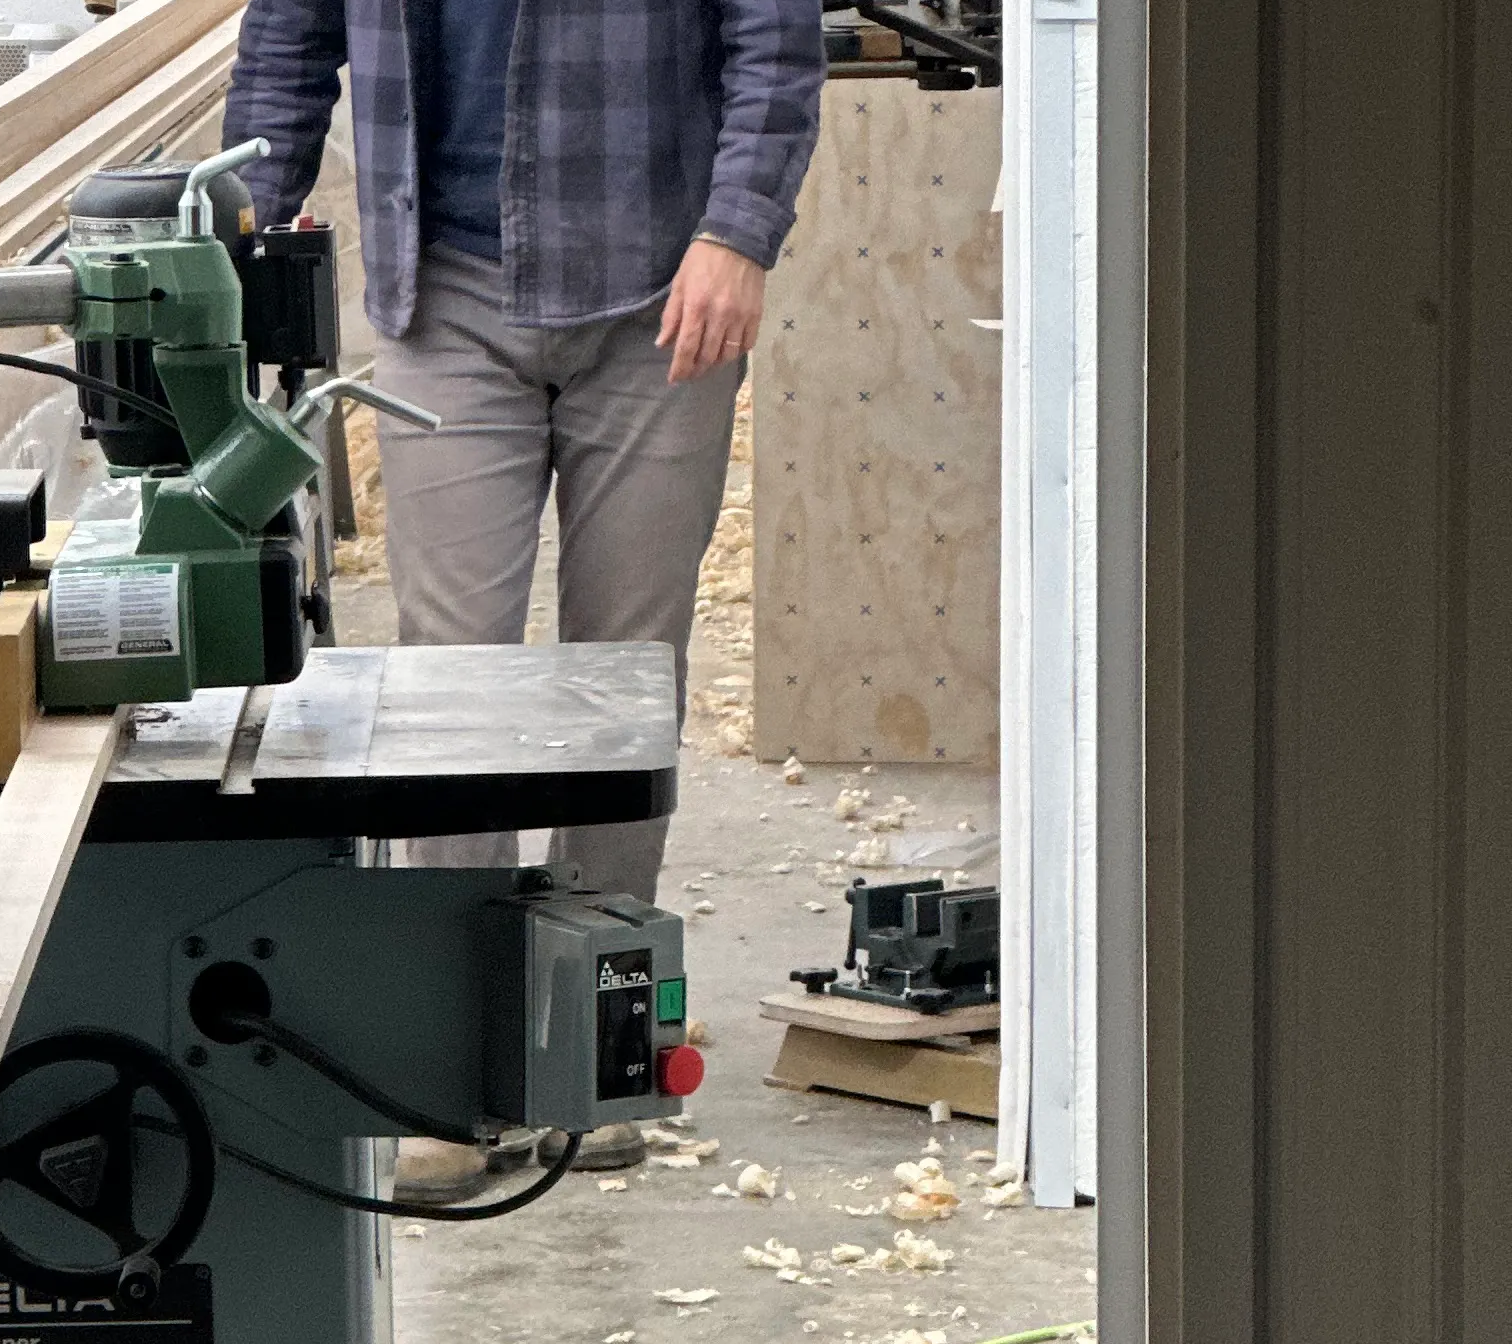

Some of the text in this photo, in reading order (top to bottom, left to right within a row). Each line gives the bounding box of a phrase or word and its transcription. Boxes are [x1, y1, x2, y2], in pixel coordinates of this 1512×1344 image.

[599, 972, 649, 988] DELTA
[633, 1002, 646, 1014] ON
[627, 1064, 645, 1076] OFF
